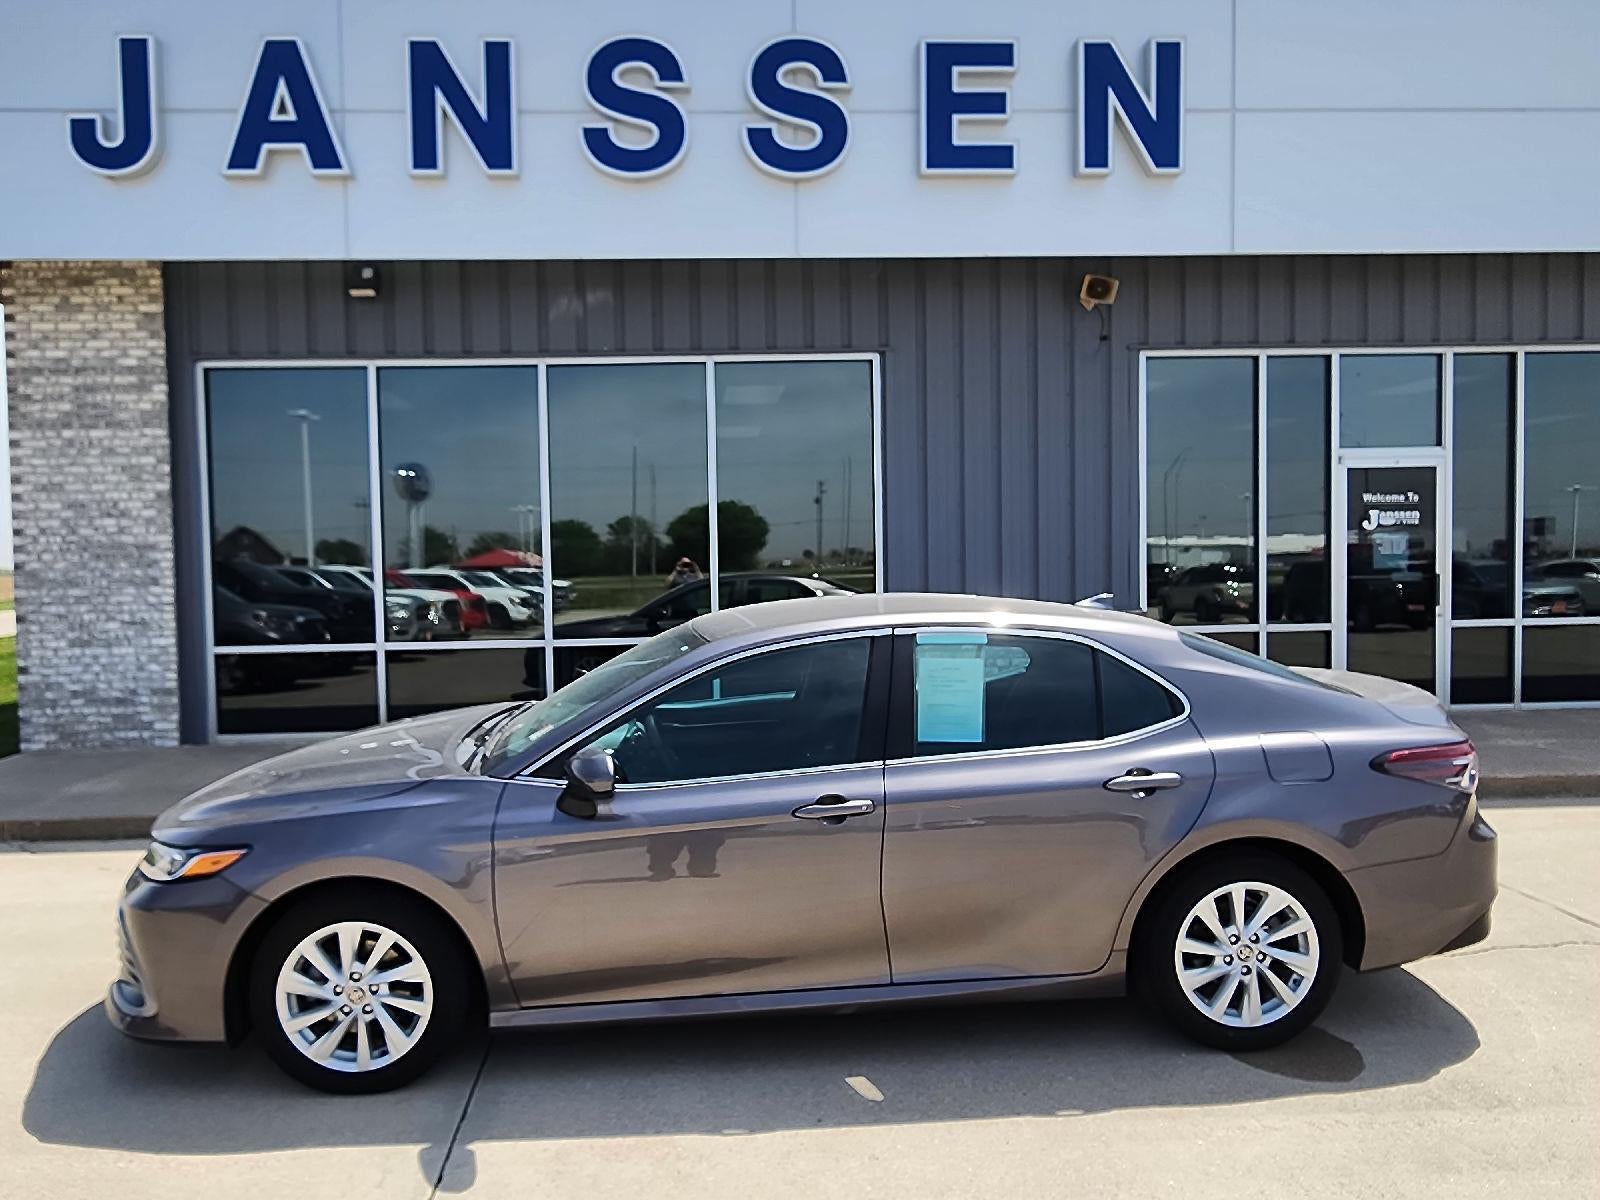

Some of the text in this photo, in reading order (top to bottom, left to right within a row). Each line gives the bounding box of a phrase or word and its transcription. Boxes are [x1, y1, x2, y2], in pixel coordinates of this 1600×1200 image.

[68, 34, 1187, 179] JANSSEN
[1362, 491, 1419, 502] Welcome To
